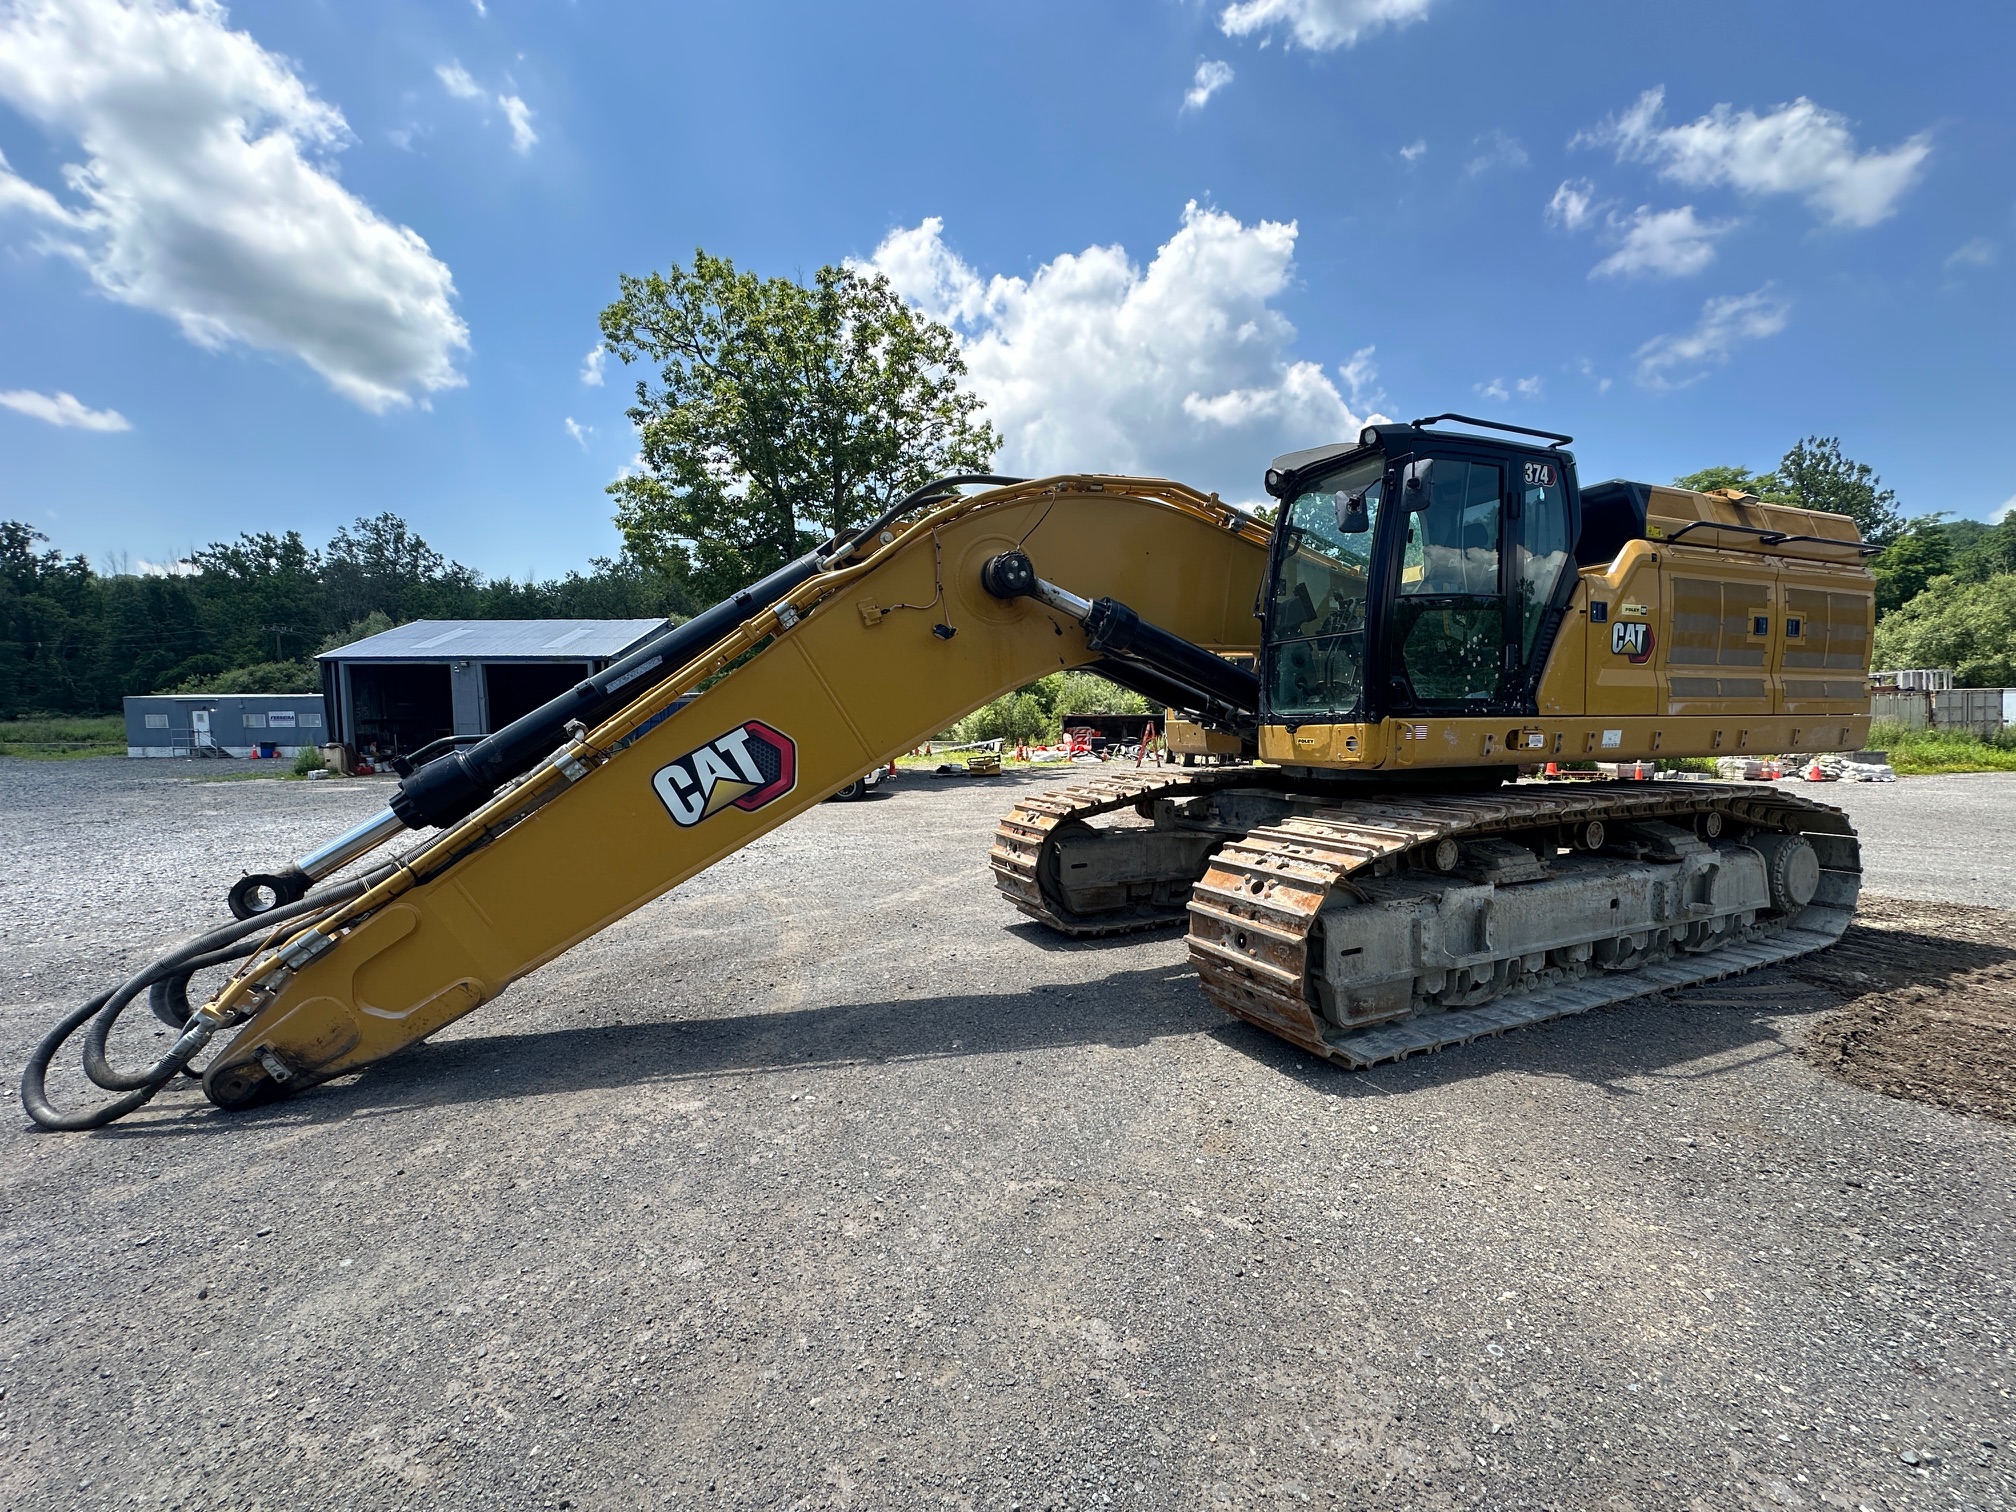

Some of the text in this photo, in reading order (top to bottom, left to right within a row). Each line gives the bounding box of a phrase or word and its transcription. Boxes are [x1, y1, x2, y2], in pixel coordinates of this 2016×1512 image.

[1524, 462, 1549, 484] 374
[1612, 622, 1647, 654] CAT
[653, 727, 766, 825] CAT
